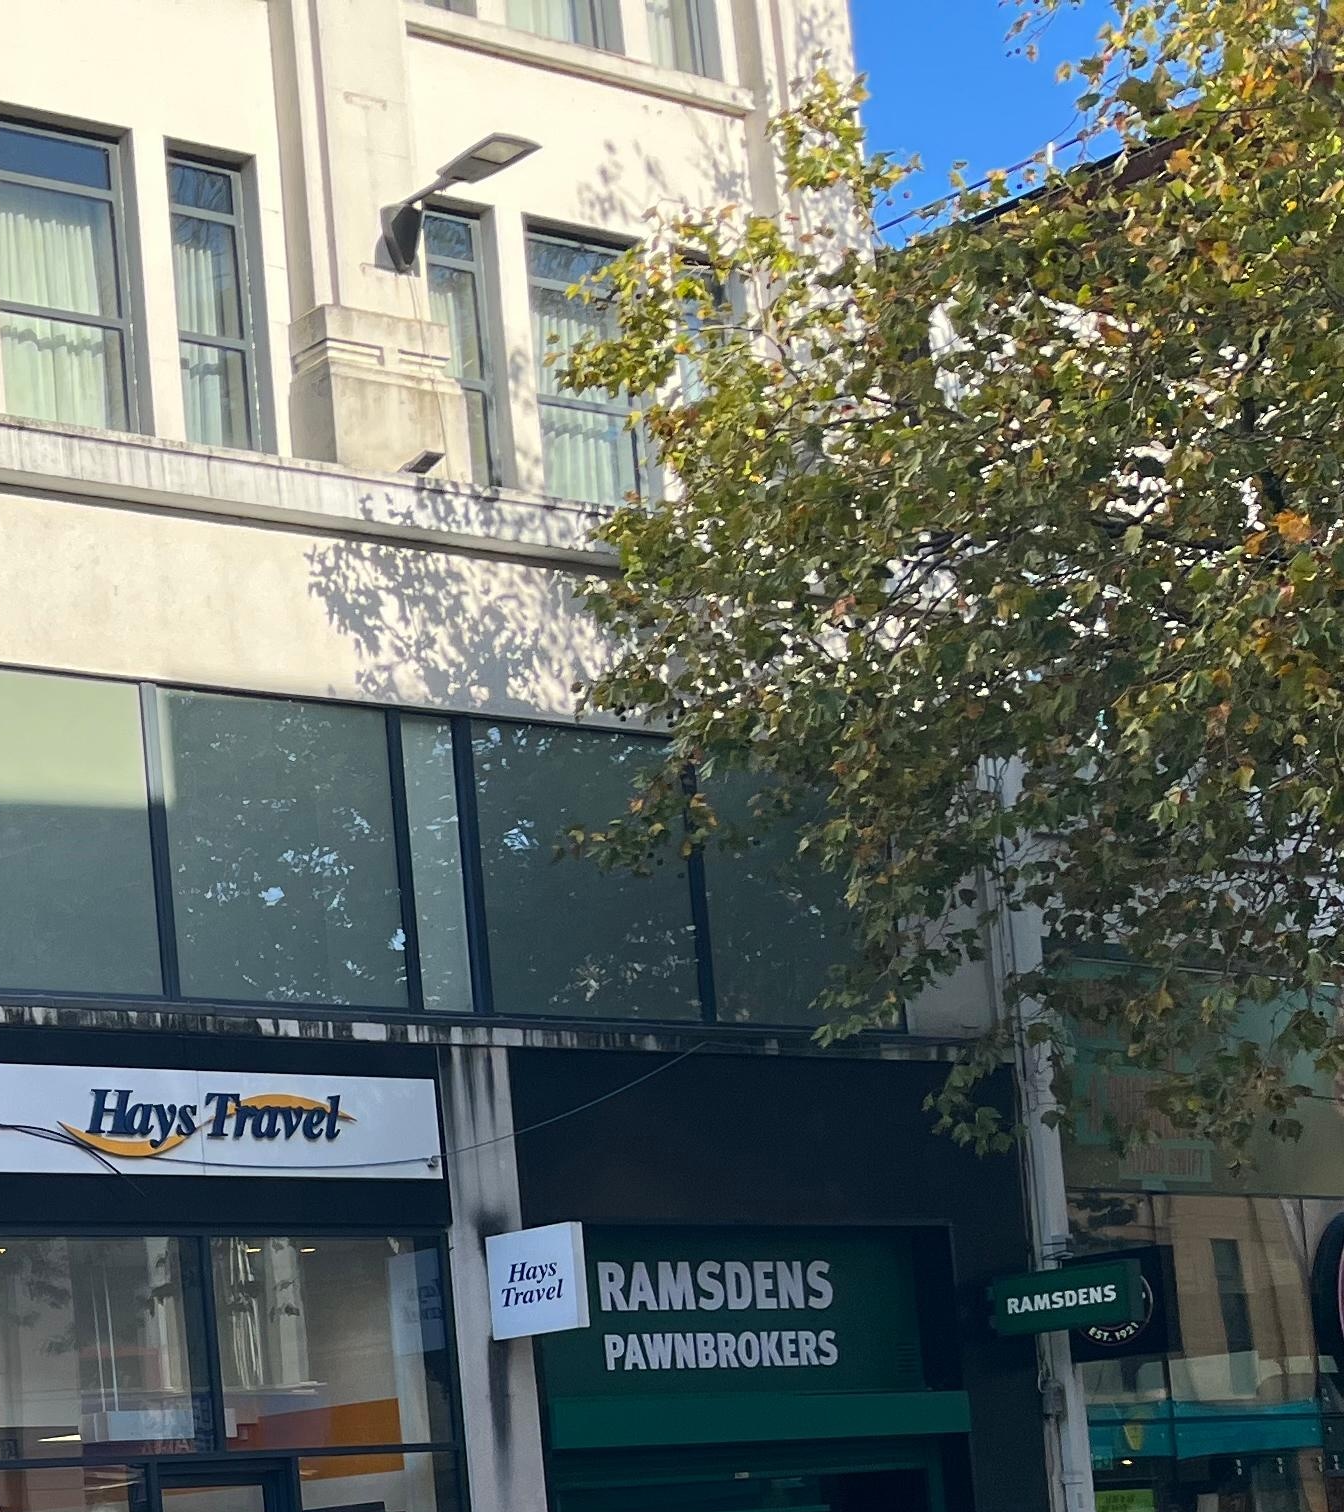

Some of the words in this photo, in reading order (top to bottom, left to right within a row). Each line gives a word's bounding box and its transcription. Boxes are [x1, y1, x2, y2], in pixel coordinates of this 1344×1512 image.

[85, 1088, 198, 1148] Hays
[204, 1091, 341, 1141] Travel
[507, 1261, 558, 1285] Hays
[597, 1260, 834, 1311] RAMSDENS
[501, 1278, 564, 1308] Travel
[1006, 1284, 1117, 1315] RAMSDENS
[604, 1330, 839, 1371] PAWNBROKERS
